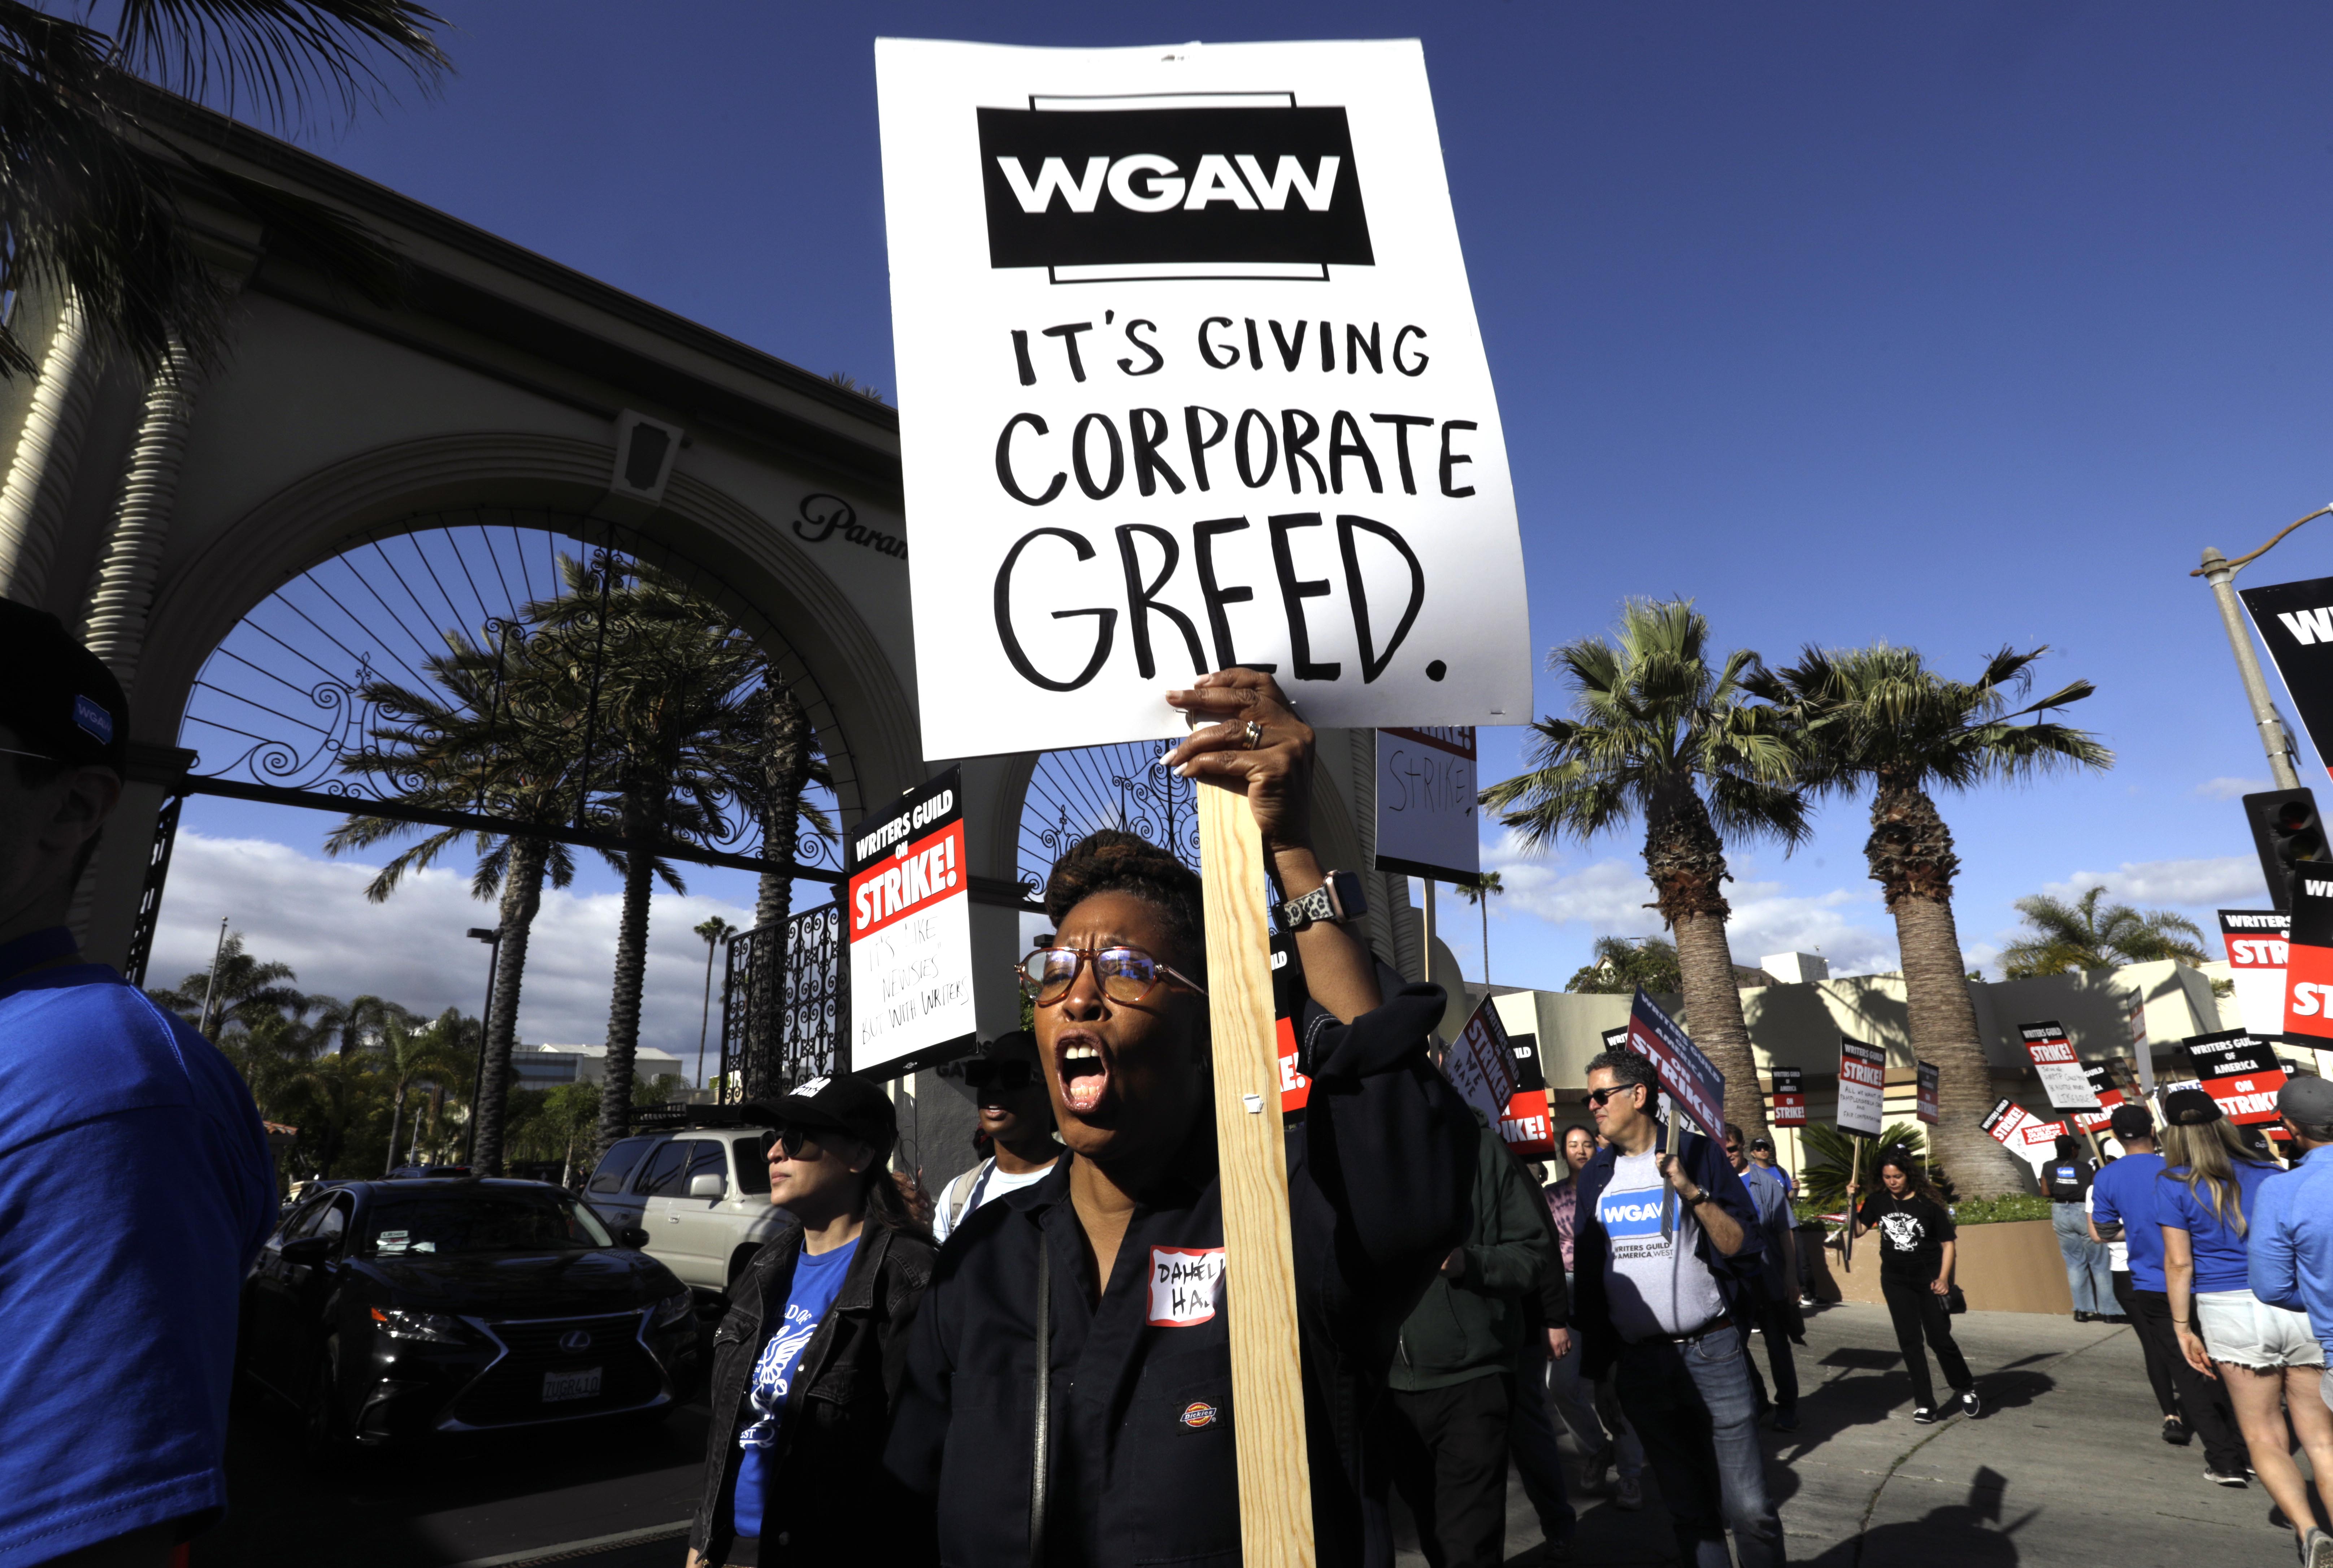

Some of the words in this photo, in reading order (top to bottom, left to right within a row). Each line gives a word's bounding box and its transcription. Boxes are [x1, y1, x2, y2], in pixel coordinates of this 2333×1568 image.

[996, 155, 1340, 213] WGAW
[1011, 310, 1165, 386] IT'S
[1198, 316, 1429, 377] GIVING
[995, 405, 1477, 505] CORPORATE
[994, 512, 1446, 692] GREED.
[78, 703, 112, 733] WGAW
[856, 812, 911, 862] WRITERS
[913, 790, 953, 830] GUILD
[895, 840, 908, 859] ON
[856, 835, 957, 930] STRIKE!
[905, 916, 938, 947] LIKE
[863, 1012, 883, 1044] BUT
[889, 998, 916, 1029] WITH
[921, 976, 969, 1015] WRITERS
[1485, 1000, 1508, 1050] WRITERS
[1506, 1048, 1520, 1081] GUILD
[1641, 993, 1688, 1047] WRITERS
[1691, 1045, 1720, 1083] GUILD
[1676, 1038, 1687, 1052] OF
[2023, 1029, 2046, 1039] WRITERS
[2046, 1027, 2063, 1037] GUILD
[1655, 1026, 1705, 1083] AMERICA
[1845, 1043, 1869, 1058] WRITERS
[1869, 1050, 1884, 1062] GUILD
[2030, 1043, 2074, 1062] STRIKE!
[2190, 1040, 2233, 1055] WRITERS
[2225, 1052, 2236, 1060] OF
[1468, 1019, 1510, 1107] STRIKE!
[1671, 1057, 1691, 1083] ON
[1843, 1061, 1882, 1087] STRIKE!
[2214, 1060, 2259, 1074] AMERICA
[1454, 1058, 1476, 1098] HAVE
[1632, 1033, 1722, 1138] STRIKE!
[1845, 1085, 1855, 1094] ALL
[2235, 1080, 2255, 1093] ON
[1775, 1106, 1805, 1119] STRIKE!
[1982, 1112, 1999, 1129] WRITERS
[1996, 1099, 2009, 1113] GUILD
[1993, 1107, 2025, 1141] STRIKE!
[2024, 1124, 2061, 1134] WRITERS
[2027, 1130, 2051, 1138] GUILD
[795, 1309, 812, 1325] OF
[1185, 1410, 1213, 1420] Dickies
